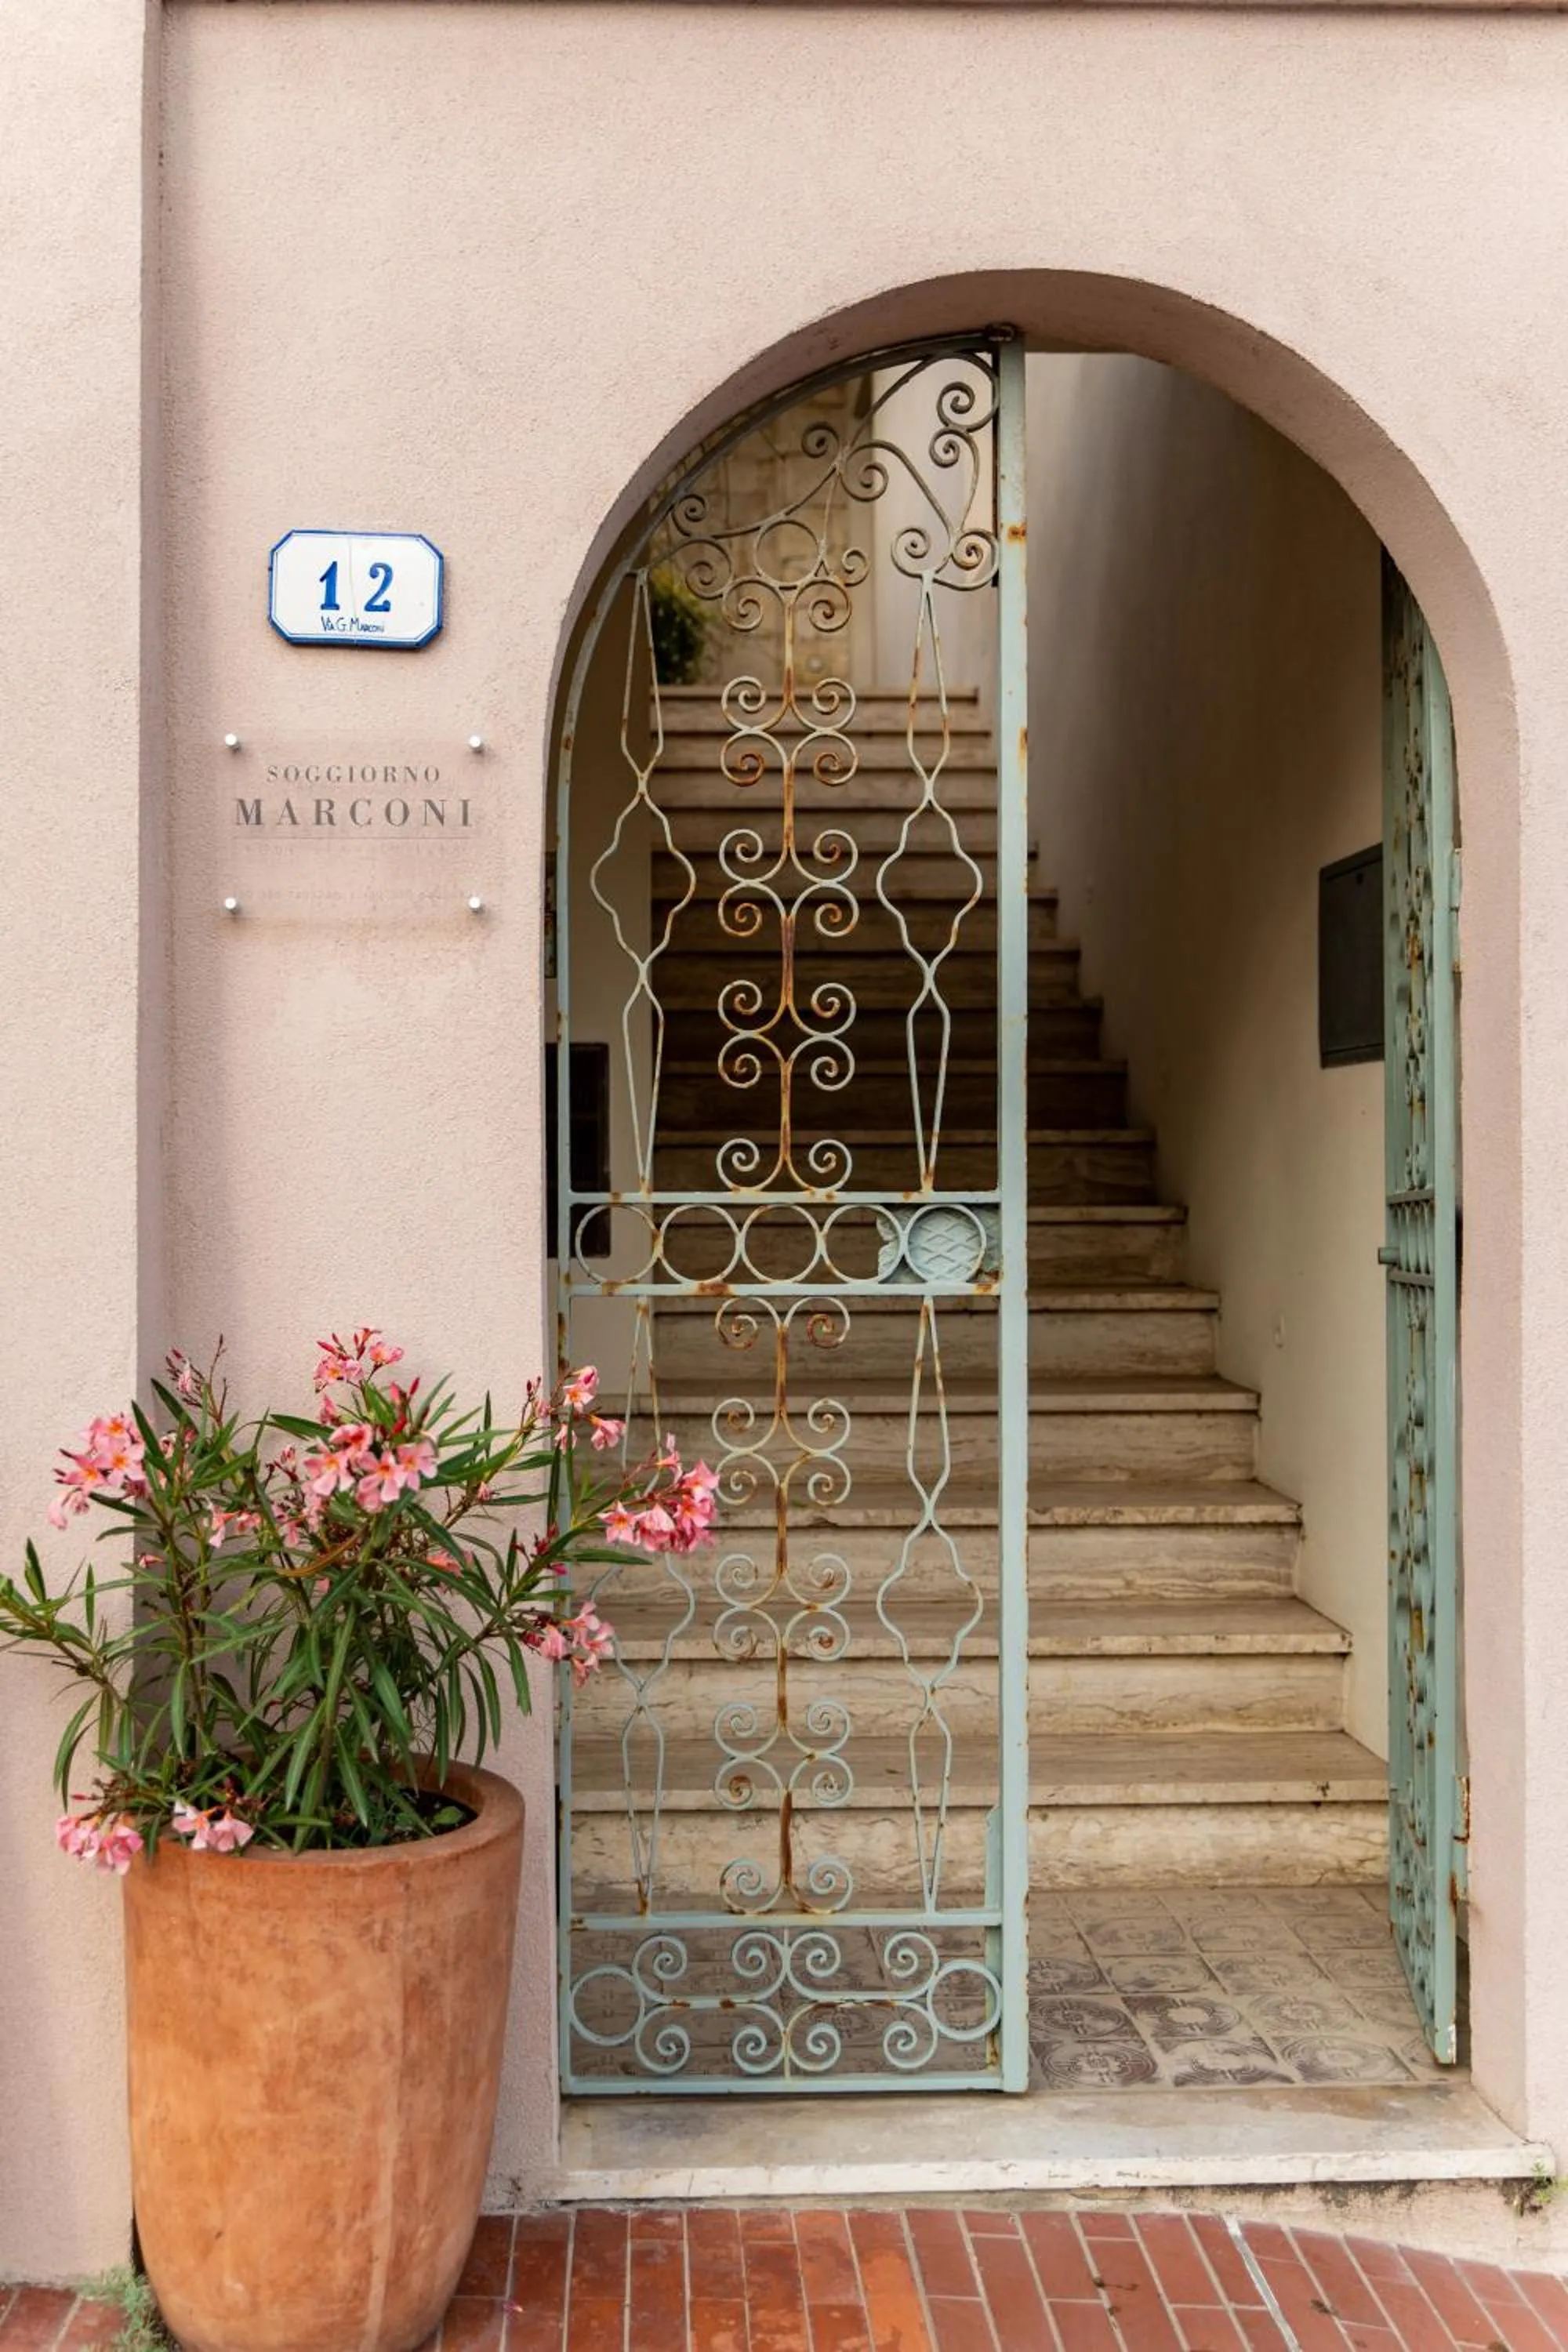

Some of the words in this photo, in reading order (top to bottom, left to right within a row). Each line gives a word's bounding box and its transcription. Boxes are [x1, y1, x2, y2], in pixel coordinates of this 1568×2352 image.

[319, 561, 394, 612] 12
[267, 764, 441, 784] SOGGIORNO
[235, 797, 473, 828] MARCONI
